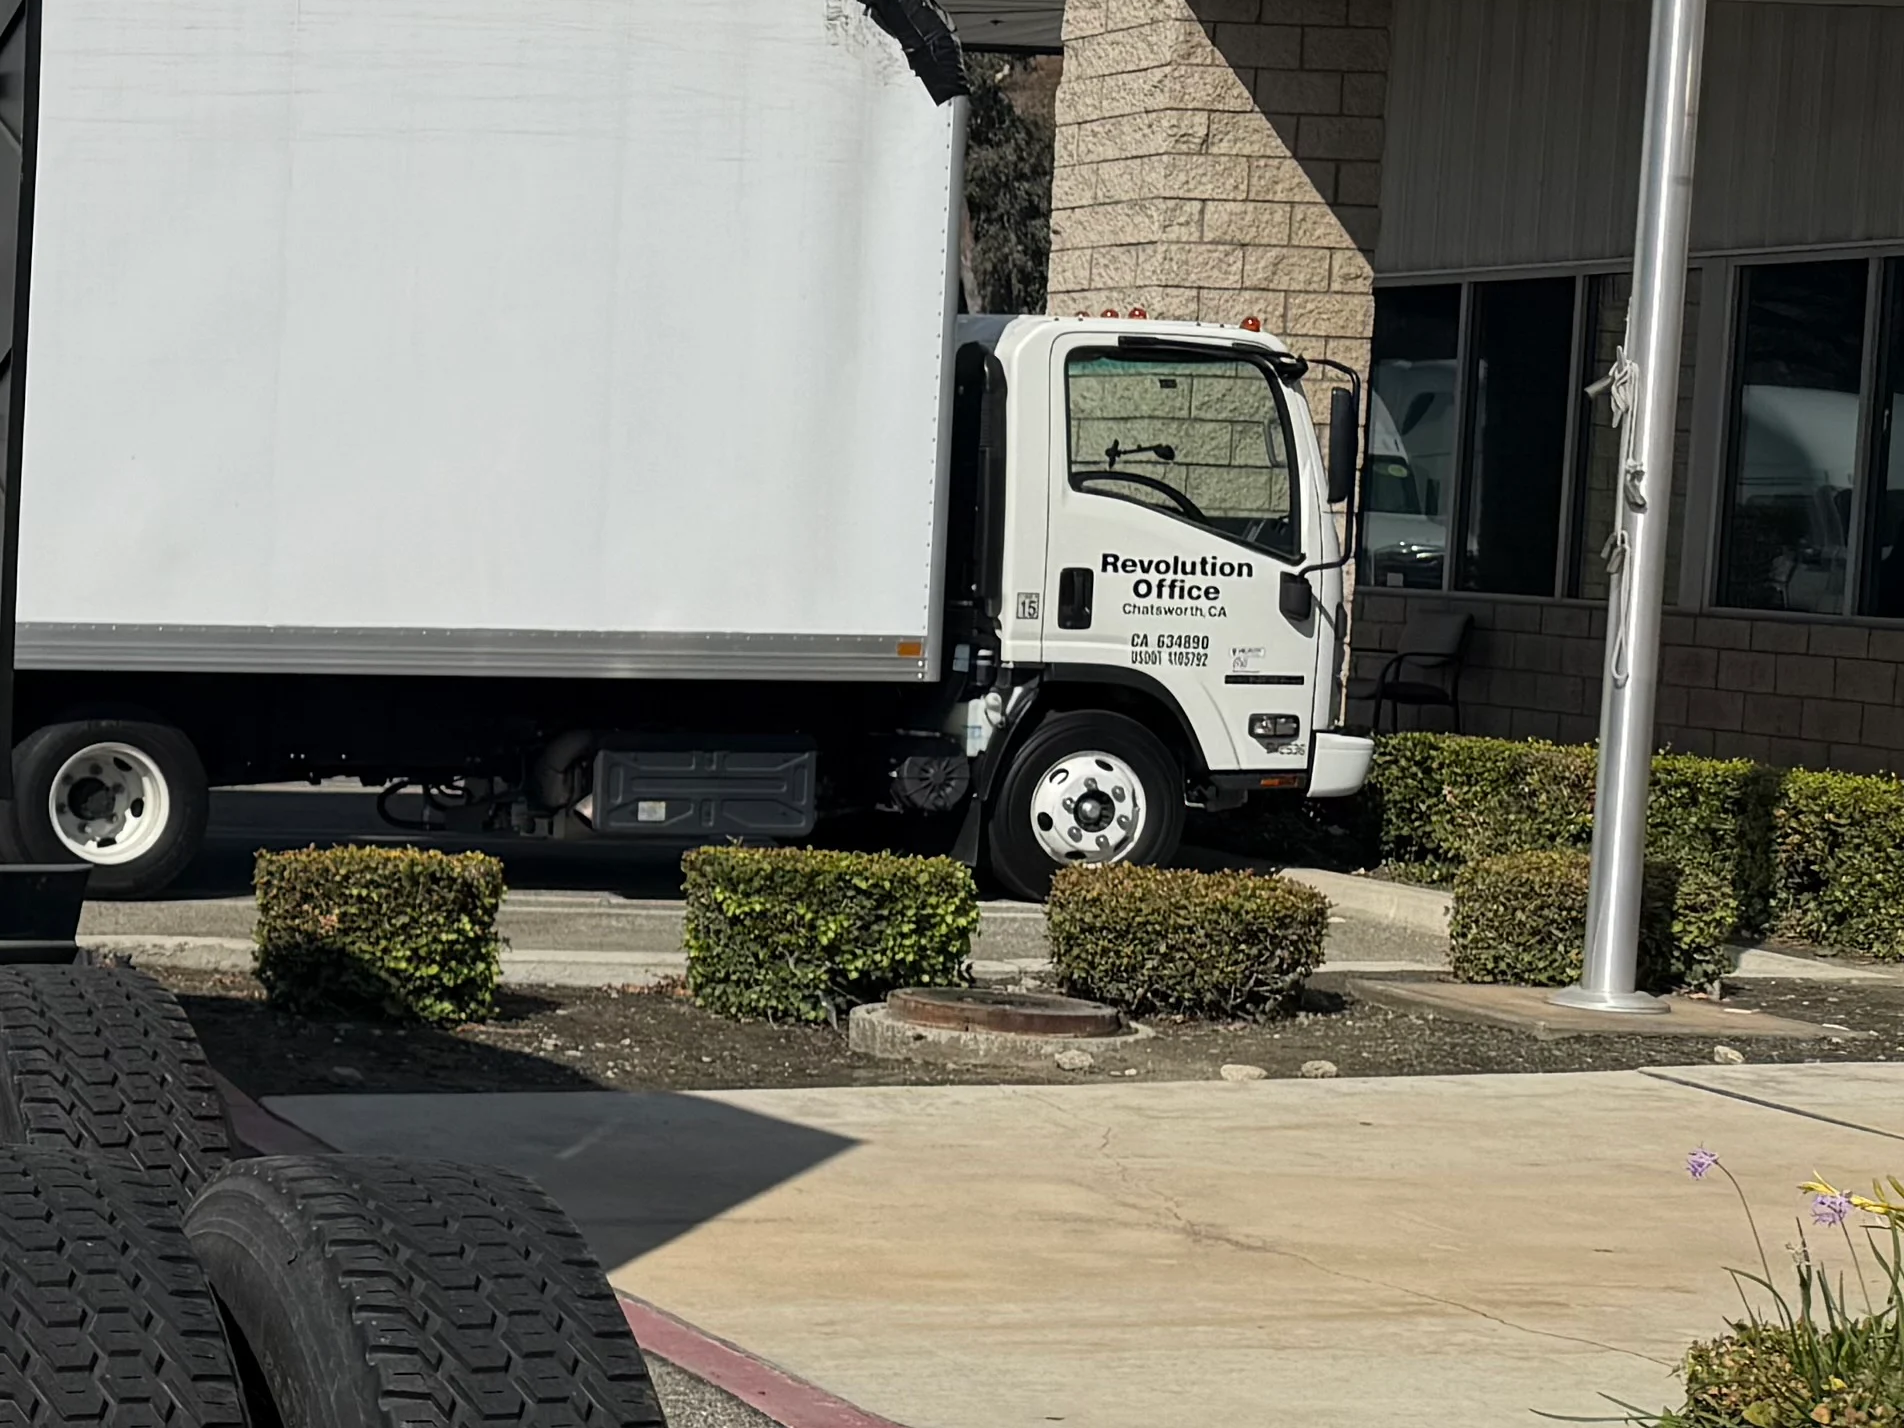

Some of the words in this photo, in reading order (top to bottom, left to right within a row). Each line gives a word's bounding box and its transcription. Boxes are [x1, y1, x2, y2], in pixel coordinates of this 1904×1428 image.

[1100, 553, 1254, 578] Revolution
[1132, 578, 1221, 601] Office
[1021, 600, 1037, 619] 15
[1131, 633, 1149, 648] CA
[1157, 634, 1210, 650] 634890
[1131, 650, 1163, 665] USDOT
